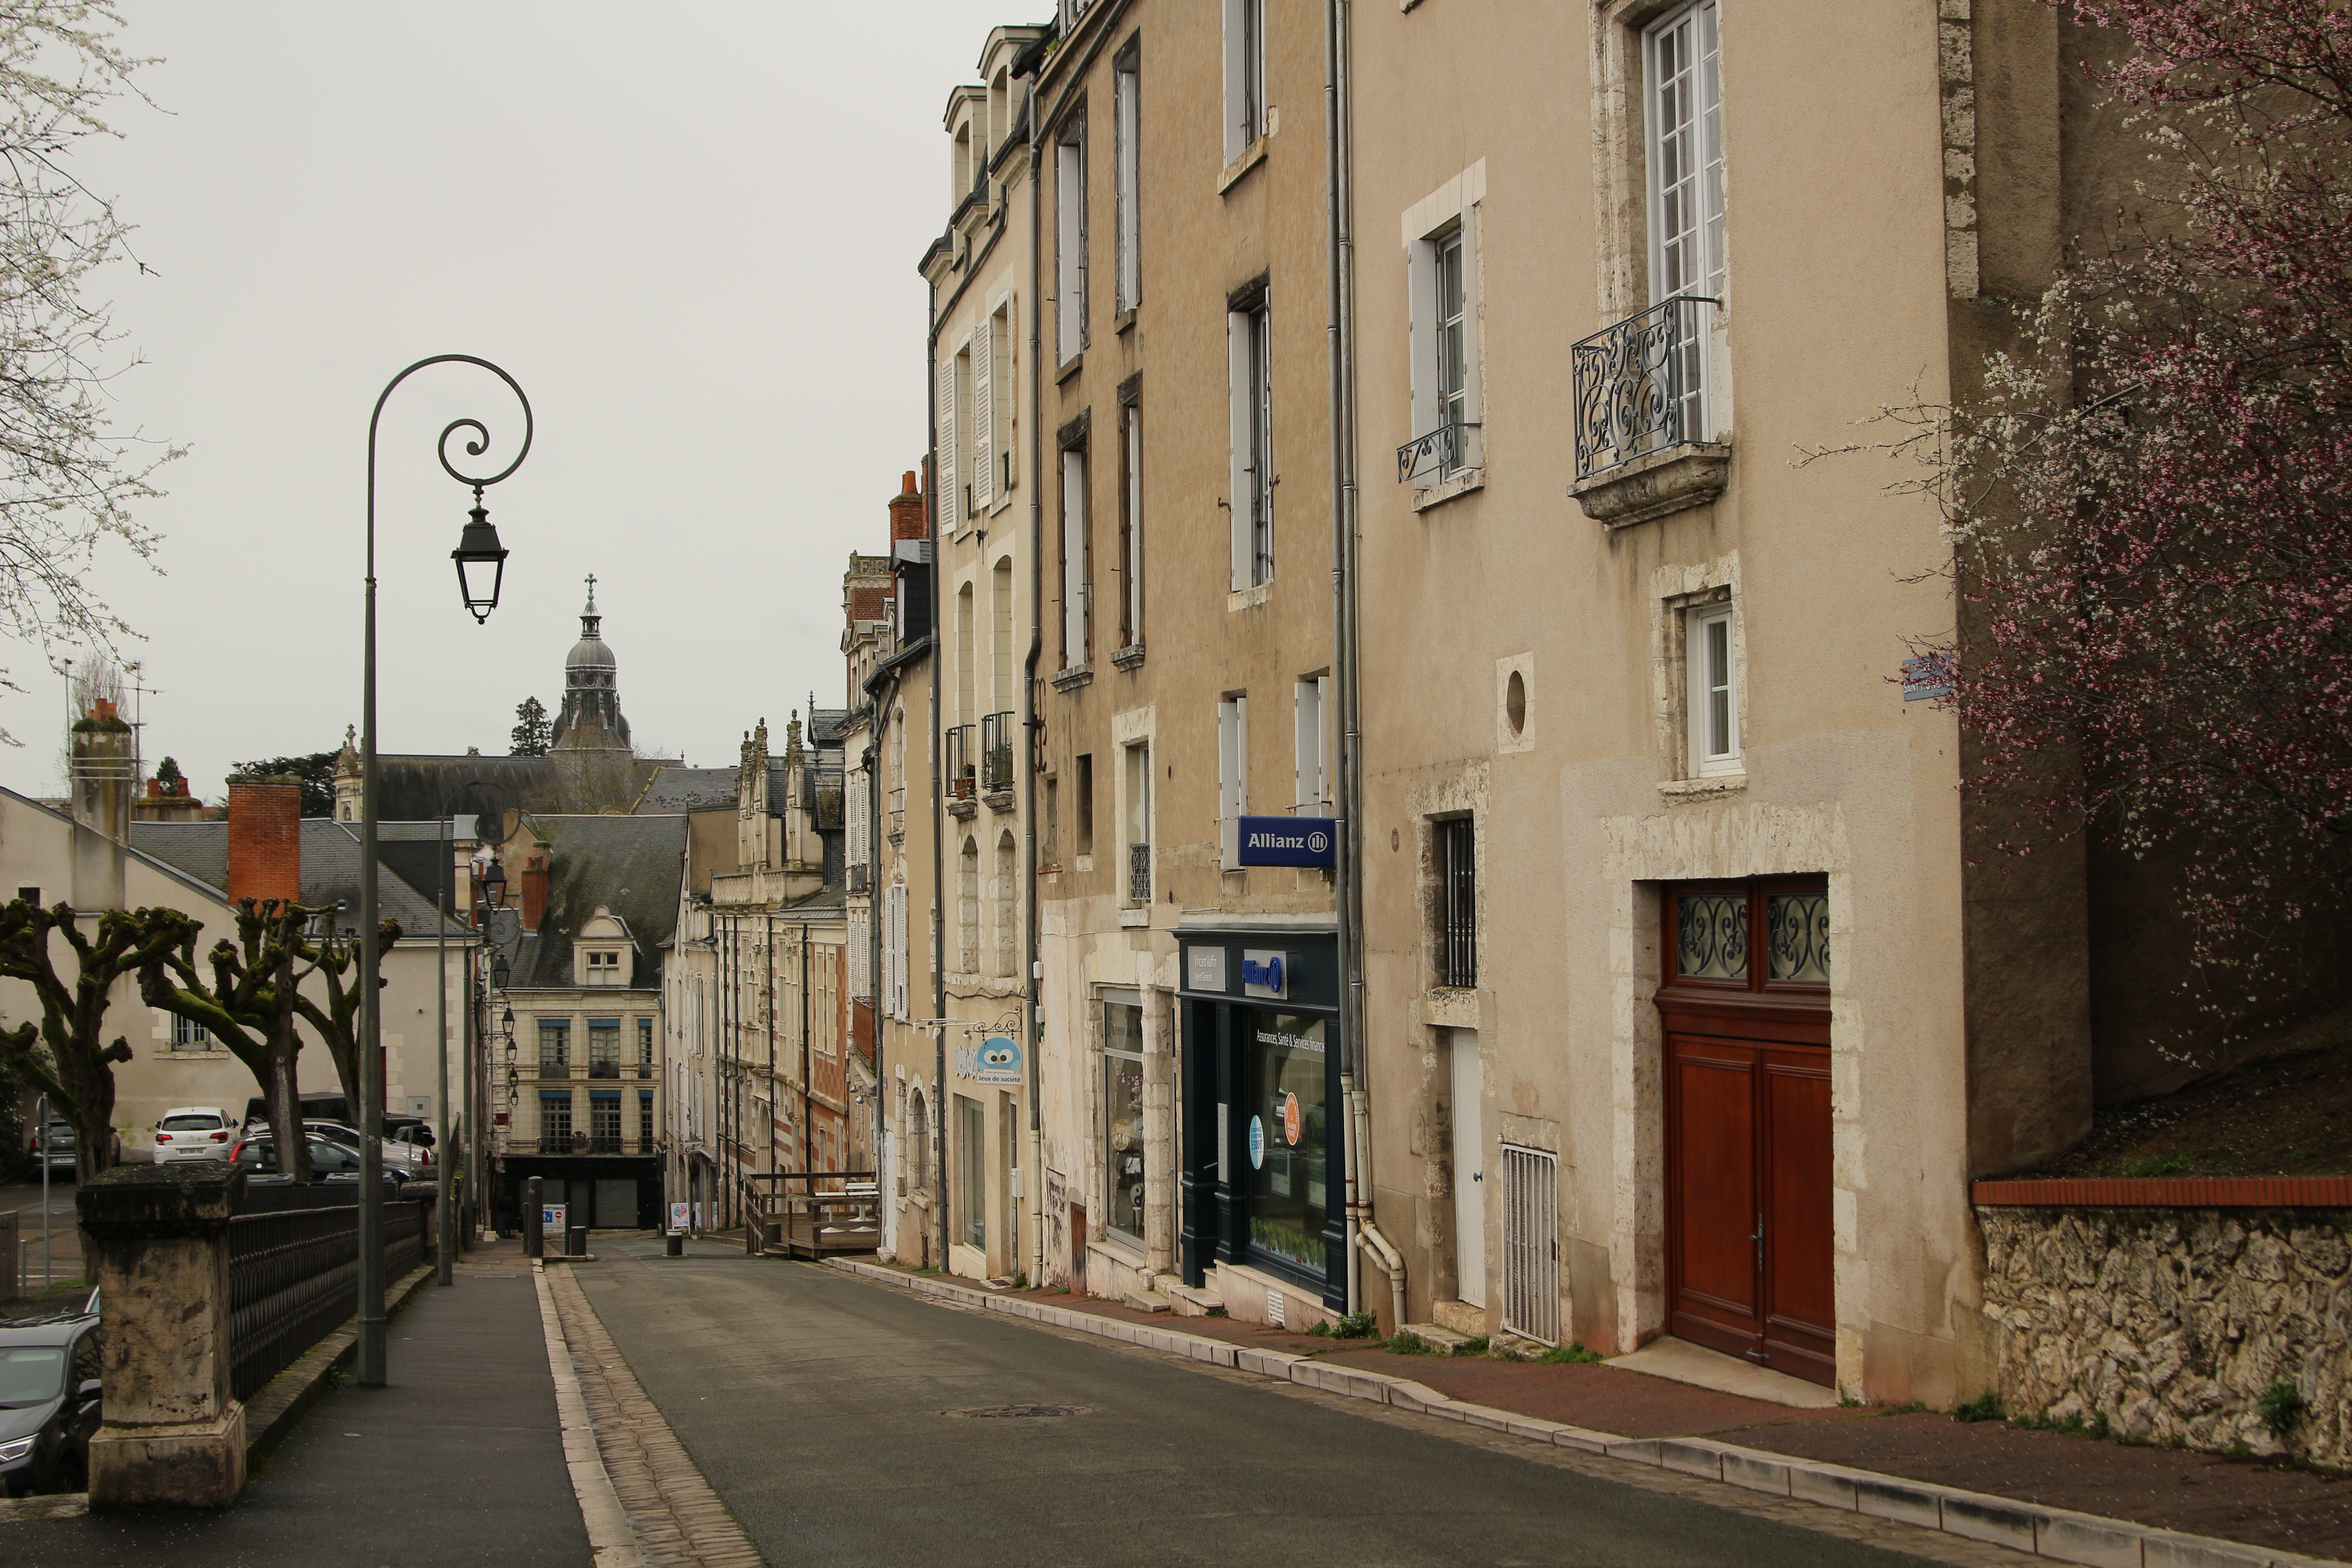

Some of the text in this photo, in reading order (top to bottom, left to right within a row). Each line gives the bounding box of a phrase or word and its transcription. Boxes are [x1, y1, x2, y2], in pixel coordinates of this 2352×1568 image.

[1904, 682, 1919, 693] SAINT
[1248, 833, 1304, 848] Allianz
[1194, 955, 1217, 968] Vincent Raffin
[1242, 960, 1270, 985] Allianz
[1257, 1029, 1278, 1046] Assurances,
[1278, 1032, 1289, 1047] Santé
[1289, 1034, 1293, 1047] &
[1293, 1035, 1309, 1050] Services
